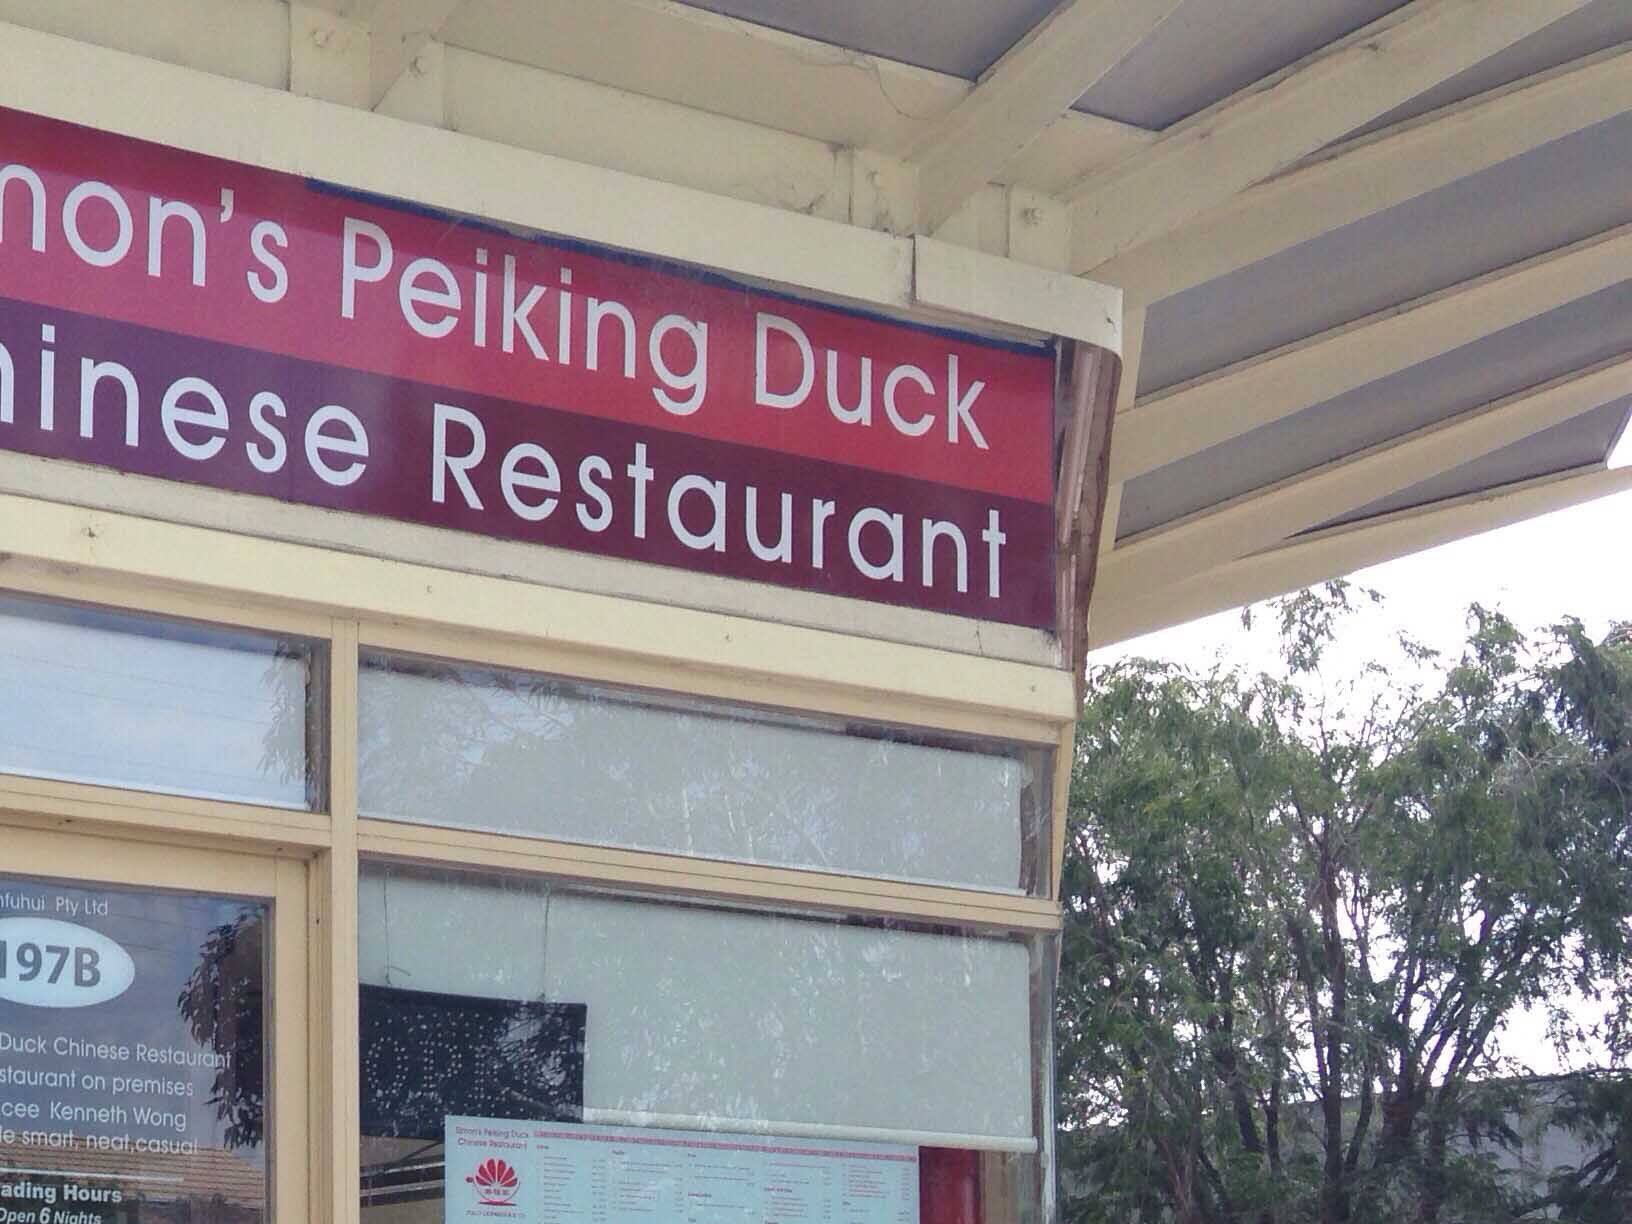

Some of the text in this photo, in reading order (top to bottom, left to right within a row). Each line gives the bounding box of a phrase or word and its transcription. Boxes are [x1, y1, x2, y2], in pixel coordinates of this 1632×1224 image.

[340, 214, 708, 418] Peiking
[753, 310, 992, 453] Duck
[430, 403, 1009, 601] Restaurant
[55, 896, 80, 916] Pty
[84, 898, 109, 917] Ltd
[53, 1036, 130, 1062] Chinese
[135, 1043, 232, 1069] Restaurant
[81, 1074, 106, 1091] on
[112, 1077, 193, 1097] premises
[50, 1101, 127, 1125] Kenneth
[132, 1107, 186, 1132] Wong
[62, 1184, 123, 1203] Hours
[39, 1207, 52, 1224] 6
